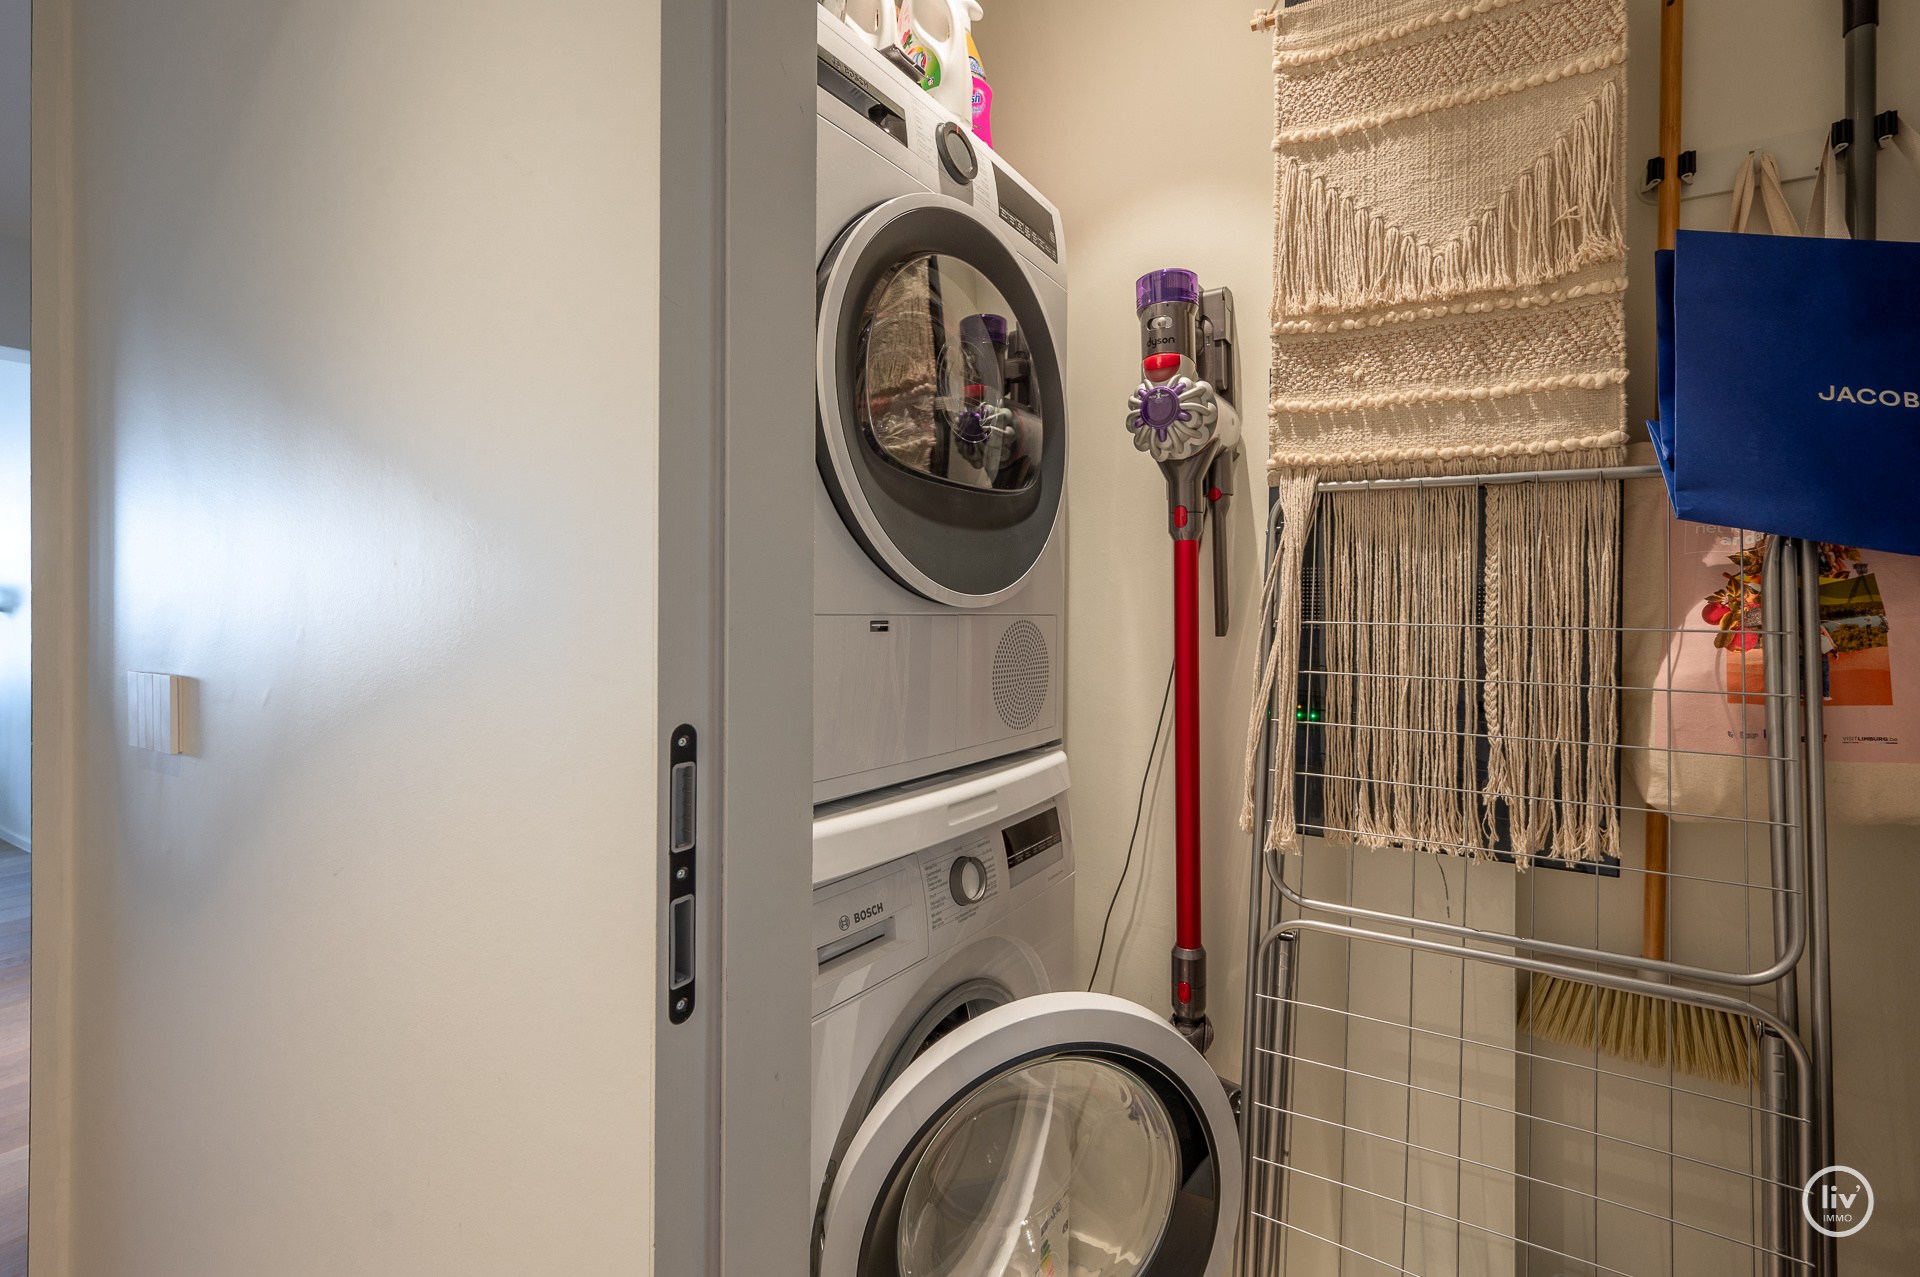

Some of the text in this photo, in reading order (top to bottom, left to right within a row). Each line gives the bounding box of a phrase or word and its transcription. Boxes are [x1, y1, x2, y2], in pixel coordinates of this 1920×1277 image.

[1146, 336, 1176, 349] dyson
[1818, 385, 1920, 408] JACOB
[853, 902, 884, 924] BOSCH
